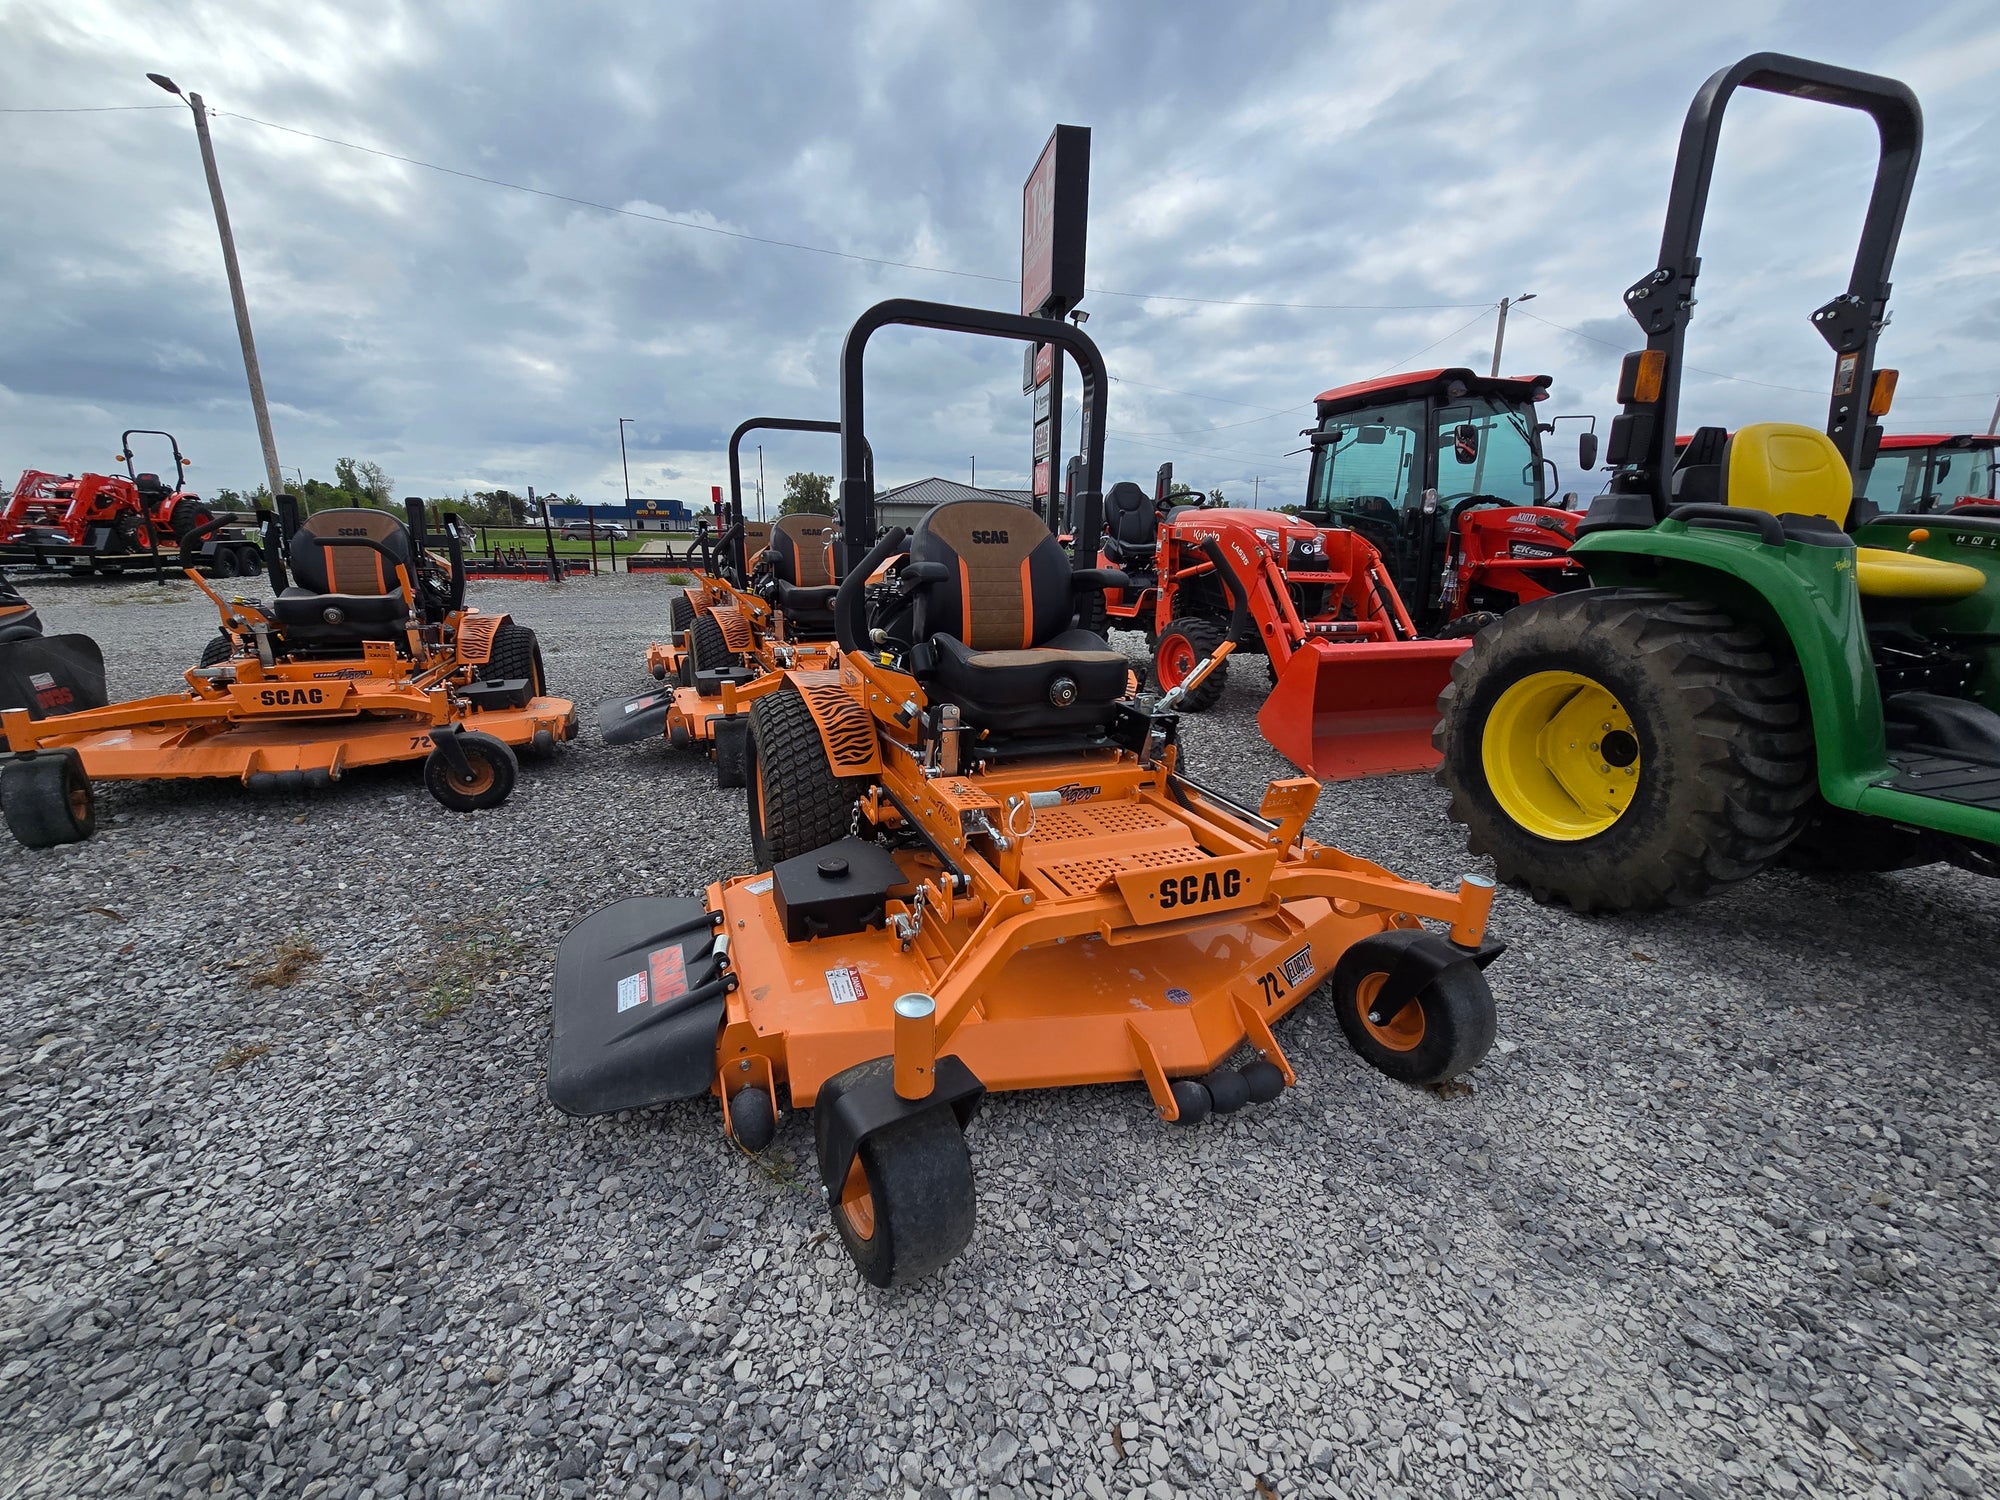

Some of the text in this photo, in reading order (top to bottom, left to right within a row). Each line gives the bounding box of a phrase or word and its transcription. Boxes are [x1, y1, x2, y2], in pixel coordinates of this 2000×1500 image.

[338, 528, 368, 536] SCAG
[972, 531, 1009, 544] SCAG
[260, 688, 323, 706] SCAG
[410, 736, 432, 750] 72
[1160, 868, 1240, 909] SCAG
[651, 946, 687, 1004] SCAG
[851, 976, 865, 998] DANGER
[1257, 971, 1285, 1007] 72
